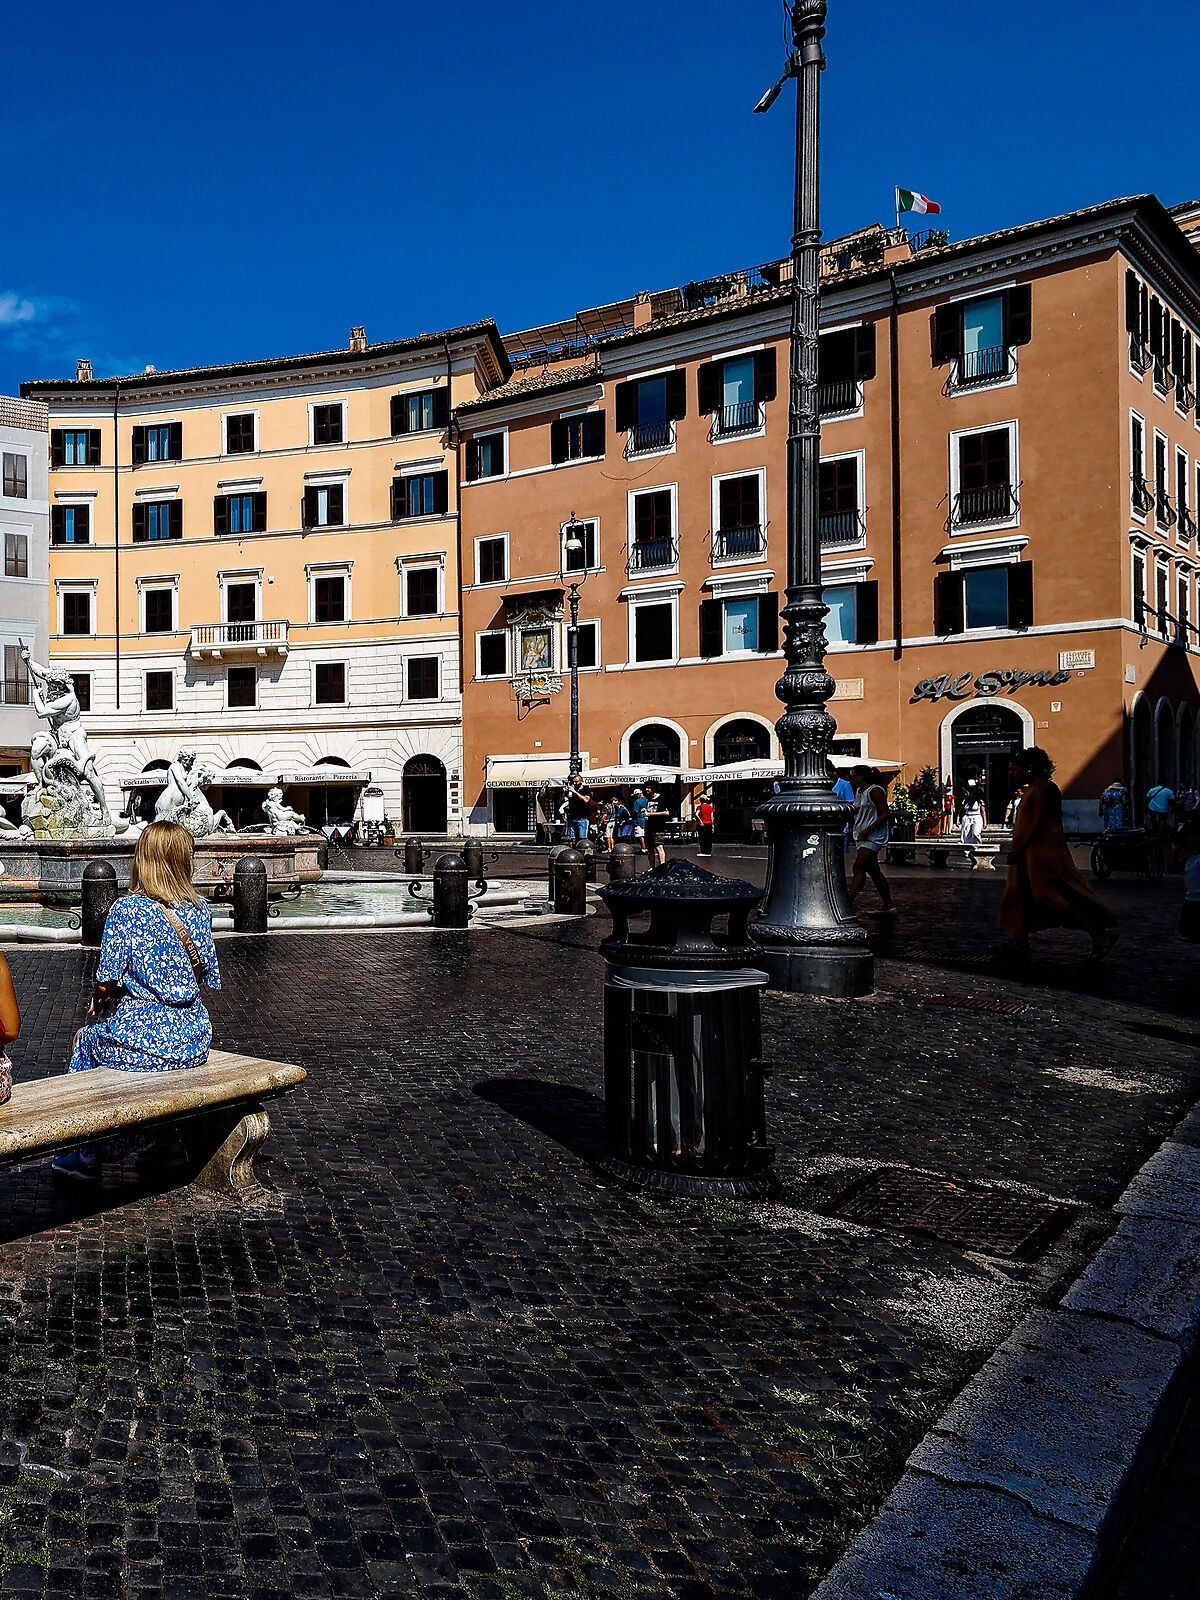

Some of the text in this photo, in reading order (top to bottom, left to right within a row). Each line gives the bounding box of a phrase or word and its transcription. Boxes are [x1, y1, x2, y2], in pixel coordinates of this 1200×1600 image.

[977, 669, 1071, 697] Sogno
[685, 773, 743, 782] RISTORANTE
[185, 937, 200, 967] LAURA
